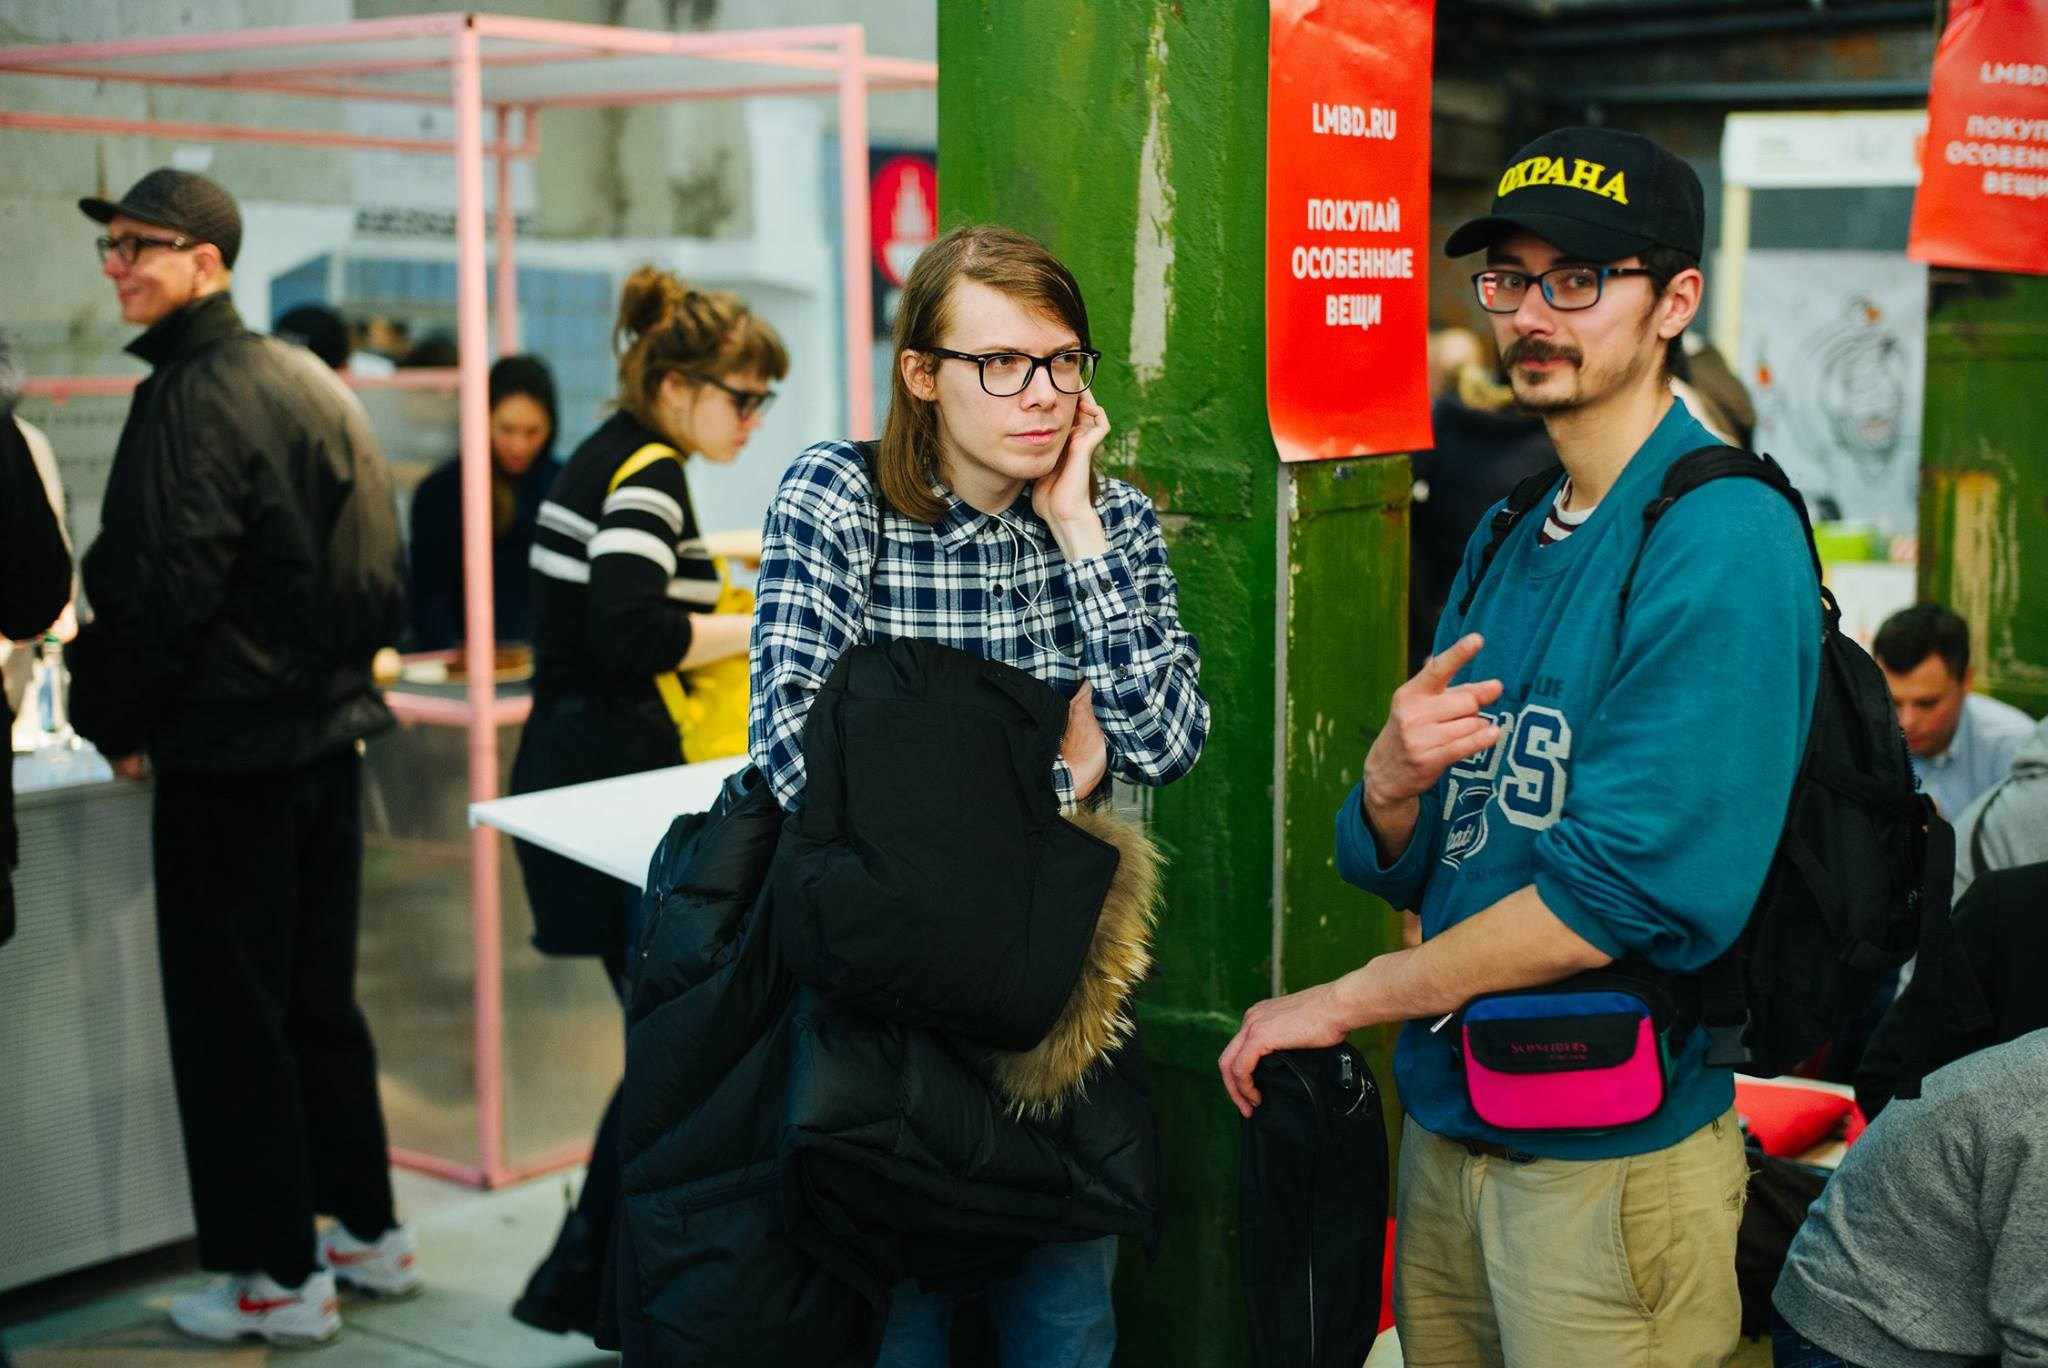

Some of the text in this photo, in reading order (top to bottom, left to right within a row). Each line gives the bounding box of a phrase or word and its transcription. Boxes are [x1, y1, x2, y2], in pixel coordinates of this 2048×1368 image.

[1312, 102, 1397, 140] LMBD.RU
[1497, 155, 1629, 205] ОХРАНА
[1307, 197, 1401, 232] ПОКУПАЙ
[1291, 246, 1414, 279] ОСОБЕННЫЕ
[1325, 294, 1382, 331] ВЕЩИ
